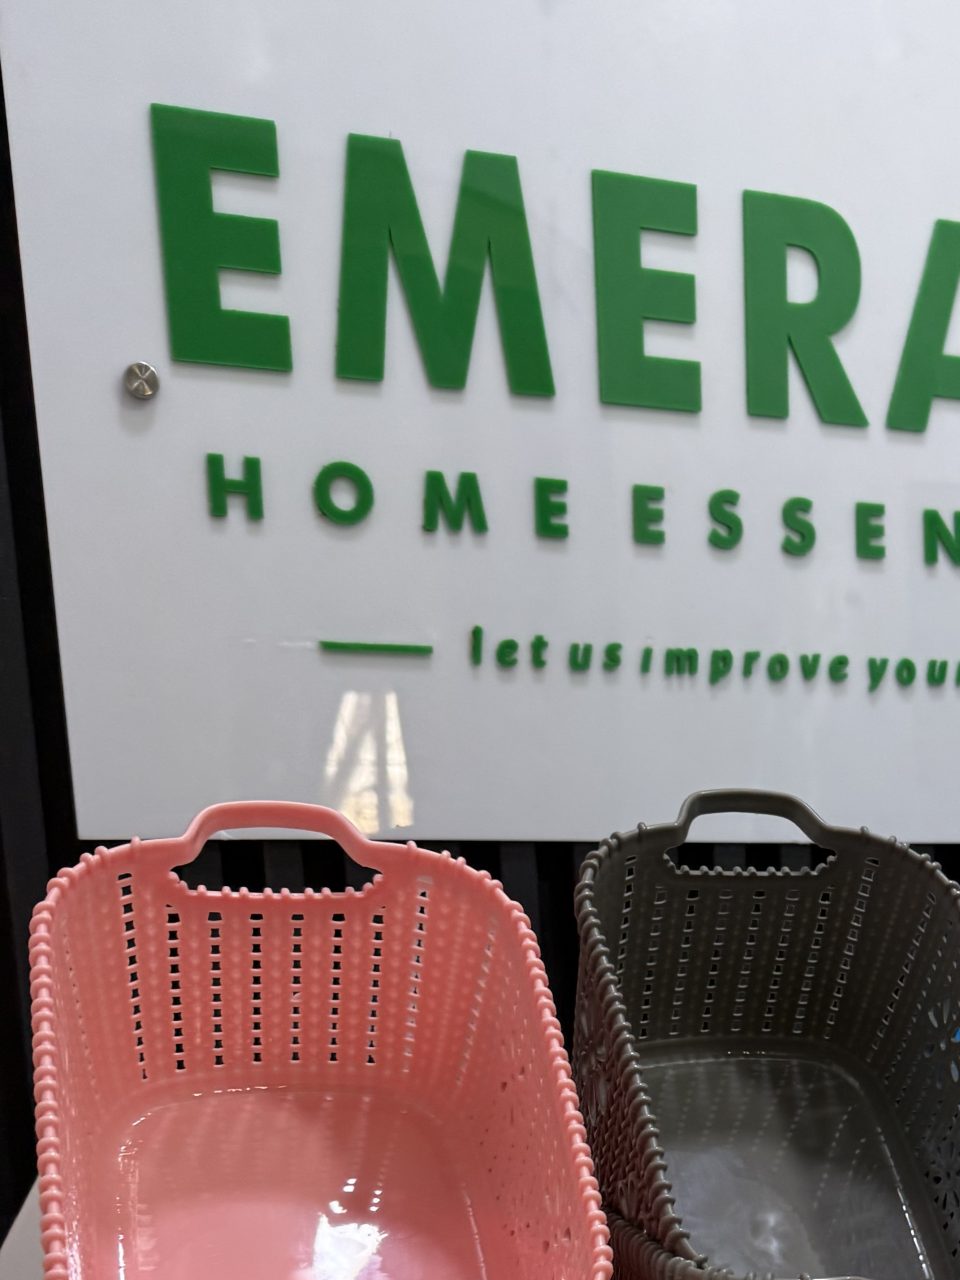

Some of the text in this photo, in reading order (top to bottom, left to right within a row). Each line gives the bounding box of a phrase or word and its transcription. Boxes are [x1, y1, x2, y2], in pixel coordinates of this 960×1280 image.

[207, 453, 569, 541] HOME
[471, 625, 549, 669] let
[569, 642, 623, 672] us
[640, 646, 850, 685] improve
